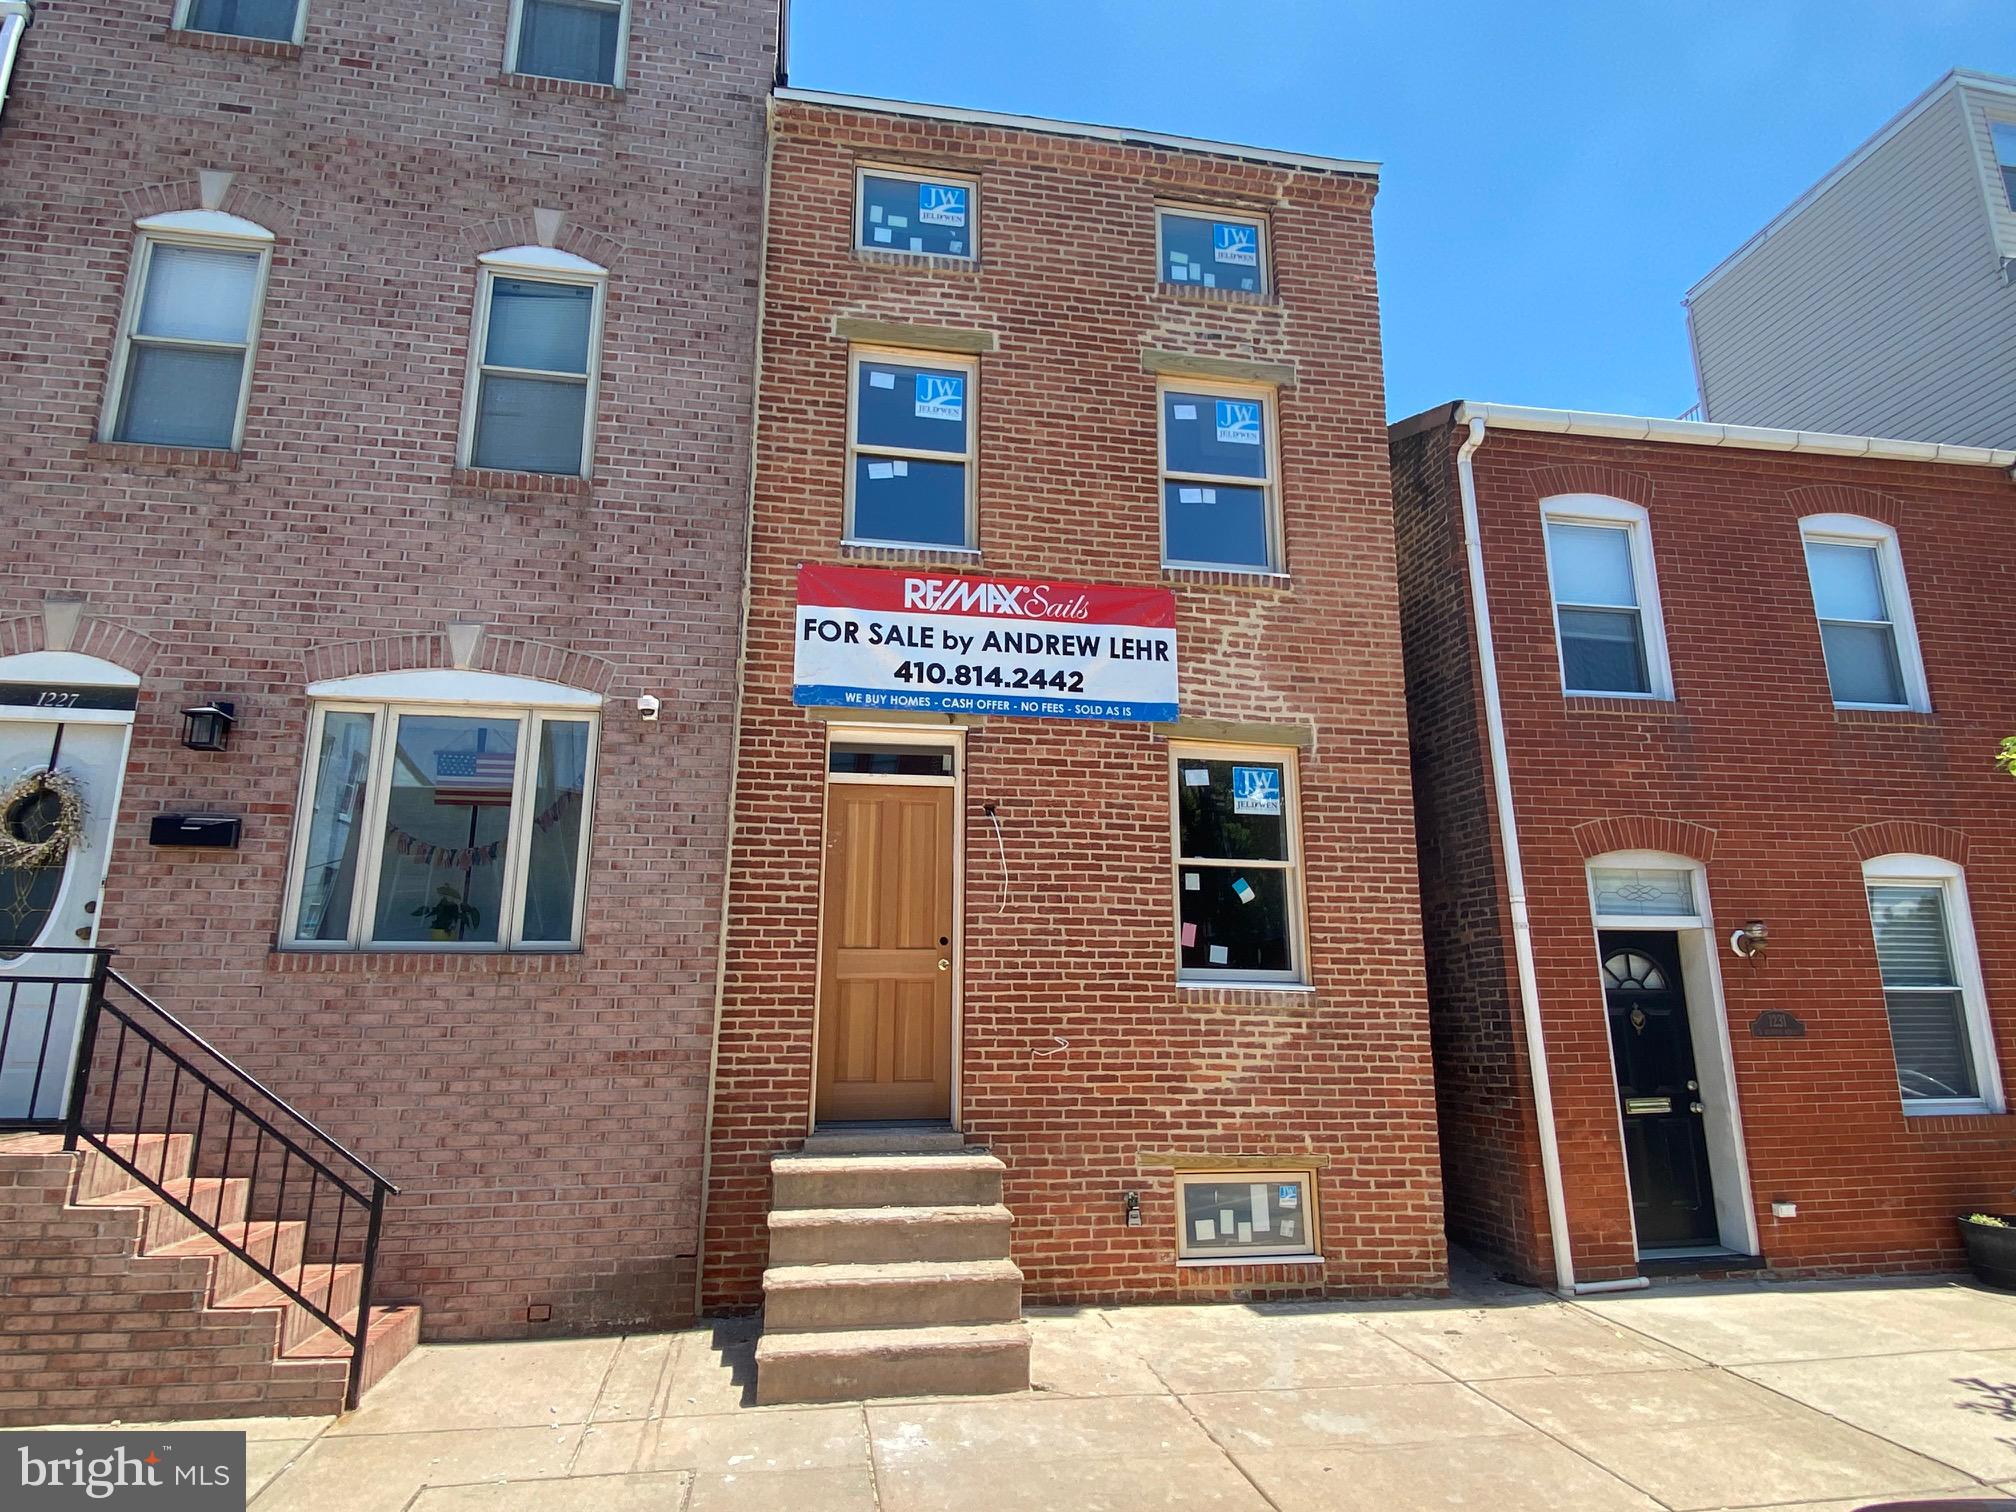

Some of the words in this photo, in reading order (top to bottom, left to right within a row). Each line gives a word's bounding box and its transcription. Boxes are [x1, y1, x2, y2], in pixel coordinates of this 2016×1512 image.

[924, 187, 959, 208] JW
[1218, 227, 1250, 248] JW
[920, 378, 958, 401] JW
[1220, 404, 1254, 426] JW
[1024, 585, 1089, 619] Sails
[804, 618, 859, 644] FOR
[868, 622, 934, 648] SALE
[943, 630, 974, 655] by
[982, 630, 1101, 657] ANDREW
[1110, 637, 1169, 661] LEHR
[894, 660, 1084, 693] 410.814.2442
[36, 691, 80, 708] 1227
[845, 692, 862, 703] WE
[865, 694, 887, 705] BUY
[890, 696, 930, 707] HOMES
[942, 697, 974, 709] CASH
[976, 699, 1010, 711] OFFER
[1021, 701, 1039, 712] NO
[1041, 703, 1064, 714] FEES
[1074, 704, 1103, 715] SOLD
[1105, 706, 1120, 716] AS
[1122, 707, 1132, 717] IS
[1238, 770, 1274, 796] JW
